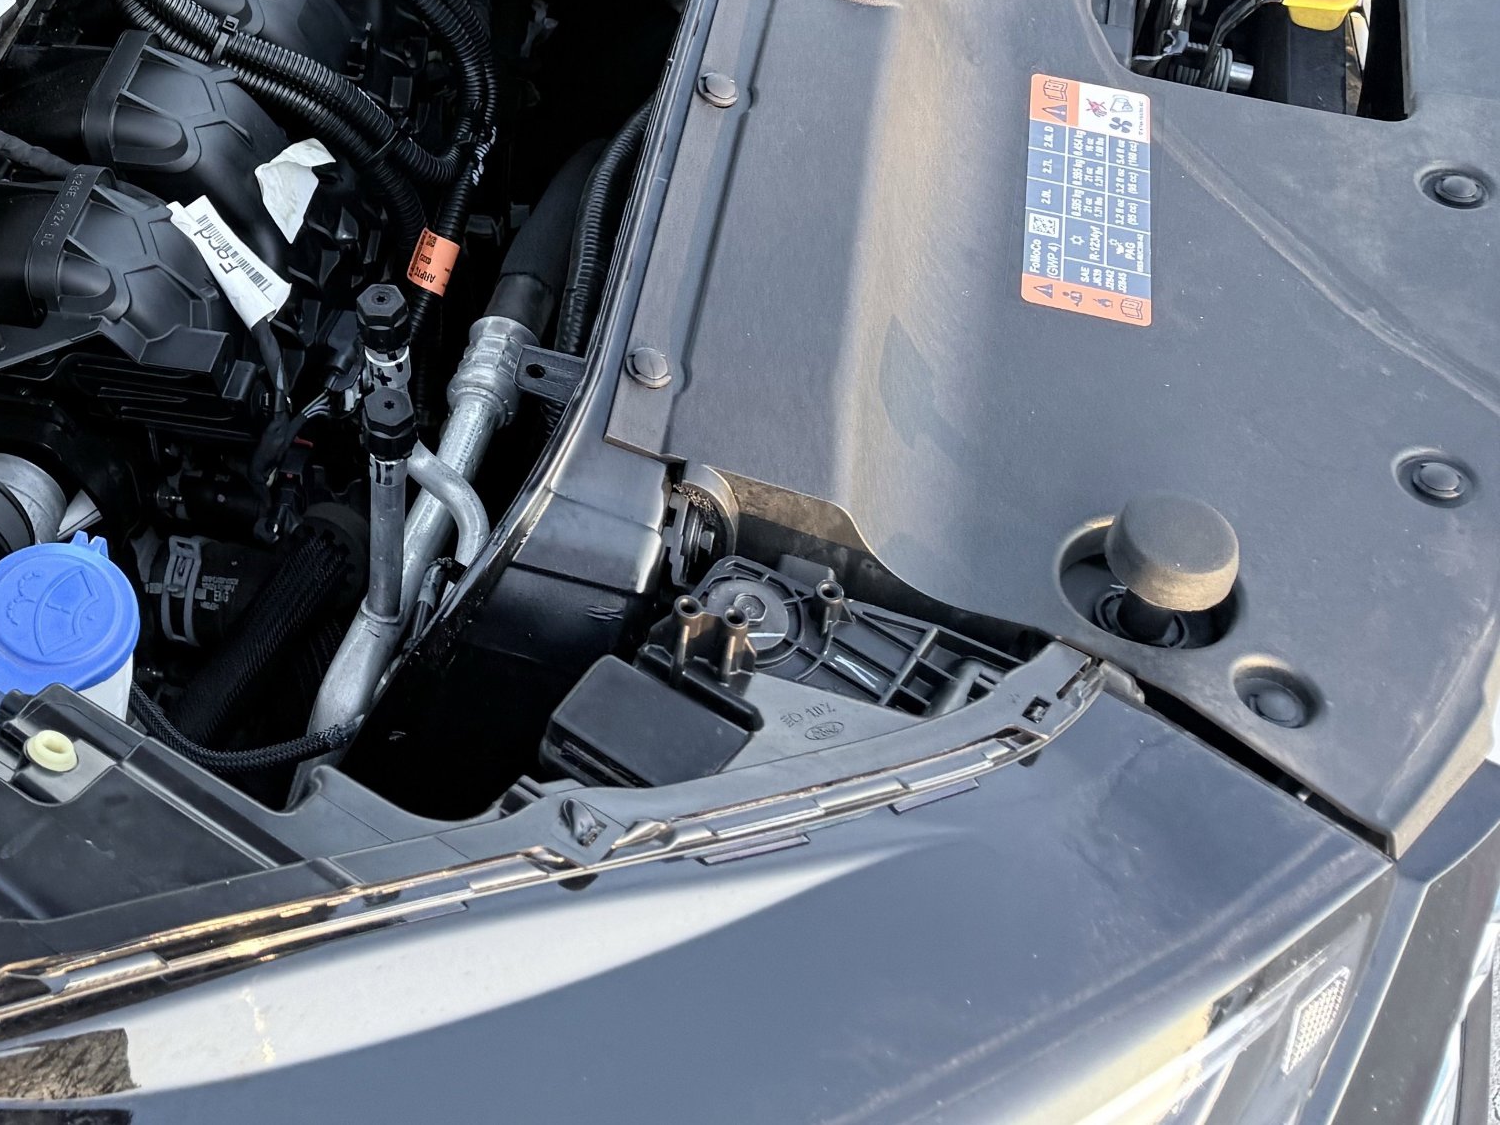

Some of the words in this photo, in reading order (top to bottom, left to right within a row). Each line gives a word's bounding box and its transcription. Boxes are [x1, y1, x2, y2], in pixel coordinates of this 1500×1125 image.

[1043, 159, 1053, 174] 2.7L
[1047, 242, 1062, 252] 4)
[1089, 226, 1103, 261] R-1234yf
[1125, 241, 1136, 261] PAG
[1029, 238, 1042, 273] FoMoCo
[1046, 252, 1061, 279] (GWP
[1080, 266, 1090, 283] SAE
